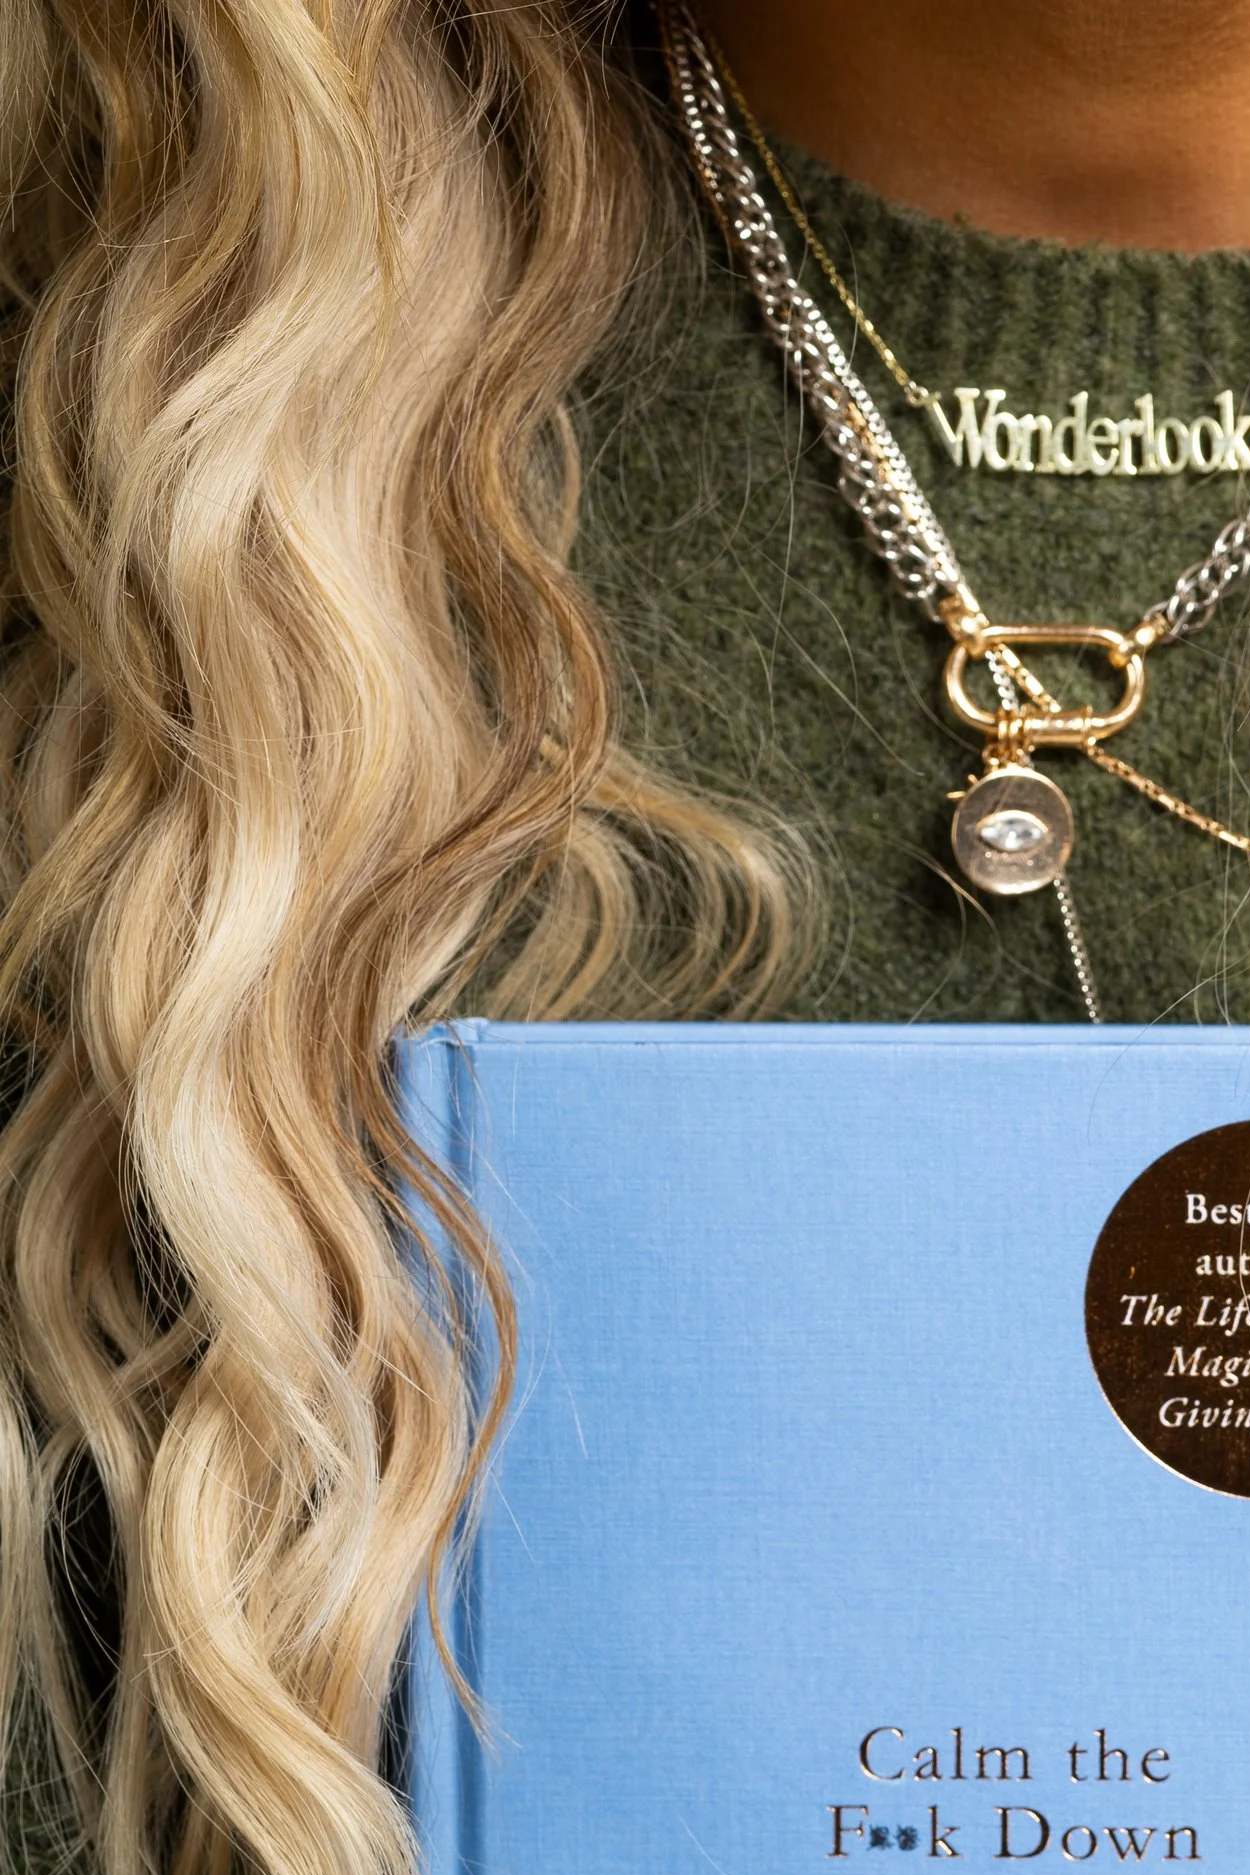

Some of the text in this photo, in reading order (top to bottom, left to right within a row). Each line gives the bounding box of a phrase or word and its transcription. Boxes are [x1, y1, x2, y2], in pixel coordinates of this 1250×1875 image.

[1120, 1294, 1182, 1326] The
[858, 1726, 1172, 1784] Calm the
[992, 1805, 1202, 1861] Down
